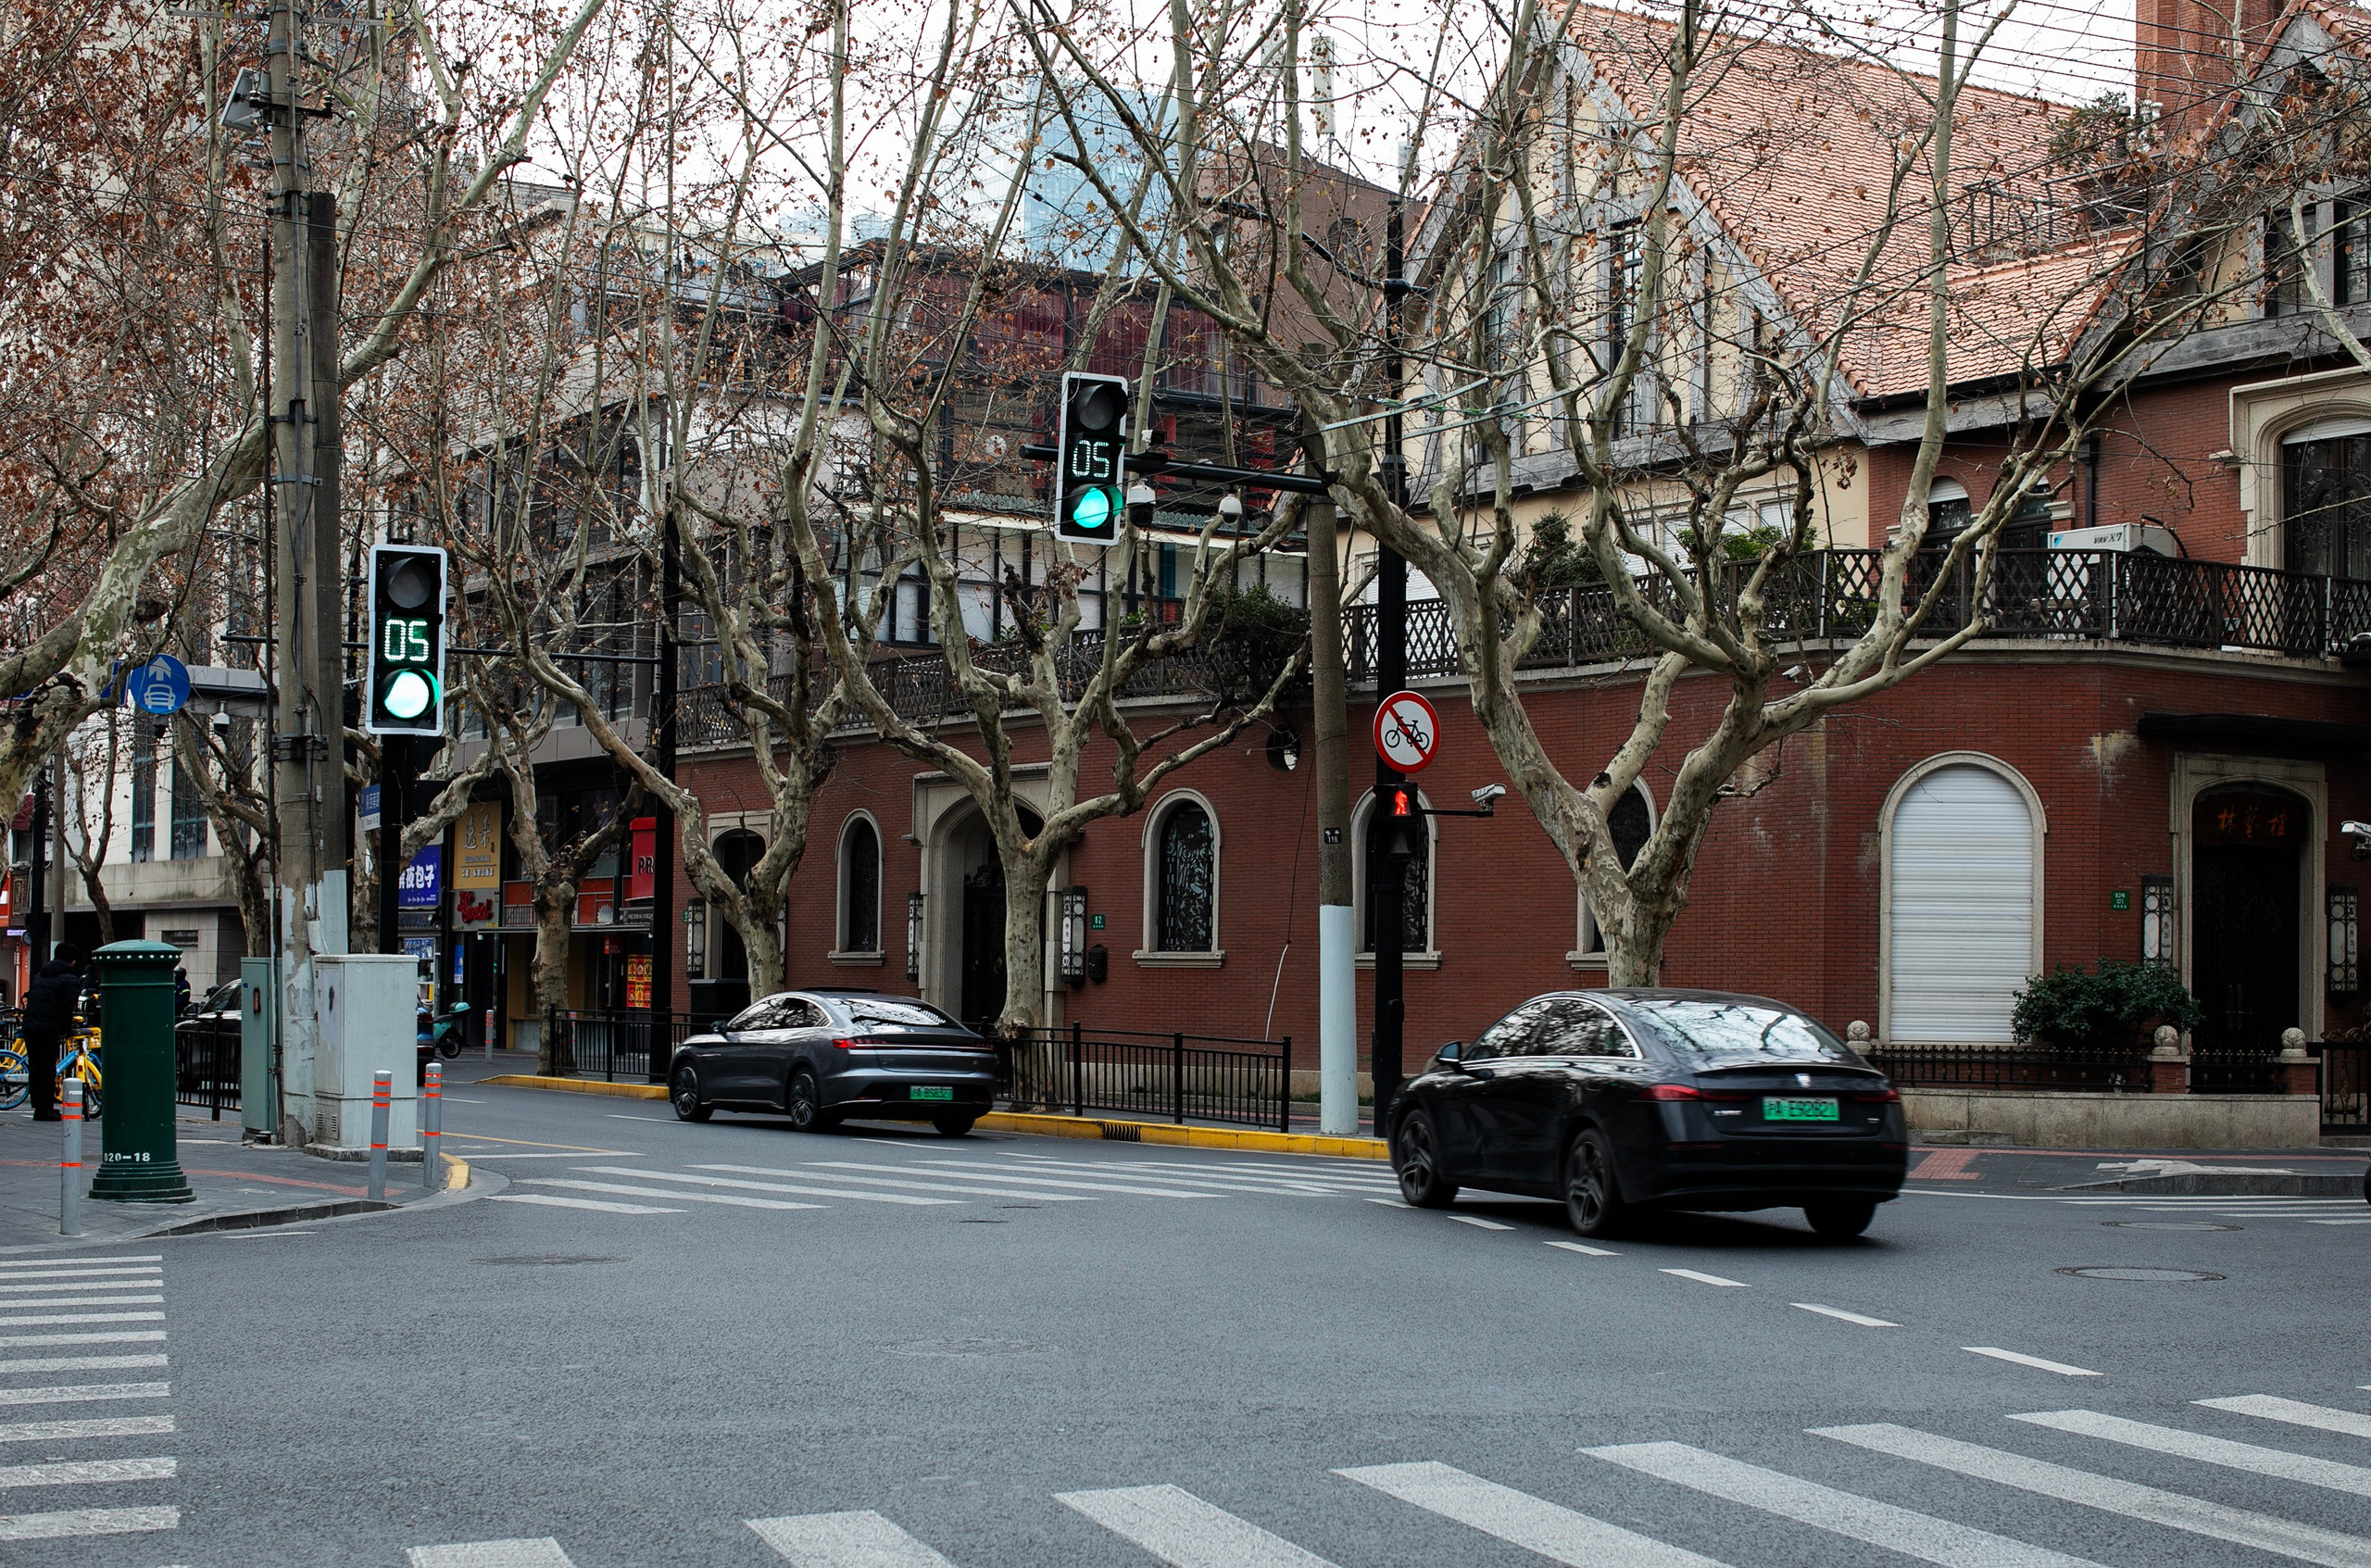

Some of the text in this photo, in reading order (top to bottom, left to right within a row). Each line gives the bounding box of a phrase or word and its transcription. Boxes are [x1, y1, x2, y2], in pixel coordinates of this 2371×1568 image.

[1073, 438, 1110, 478] 05
[2093, 536, 2109, 545] VRV
[384, 619, 429, 662] 05
[1095, 915, 1102, 924] 82
